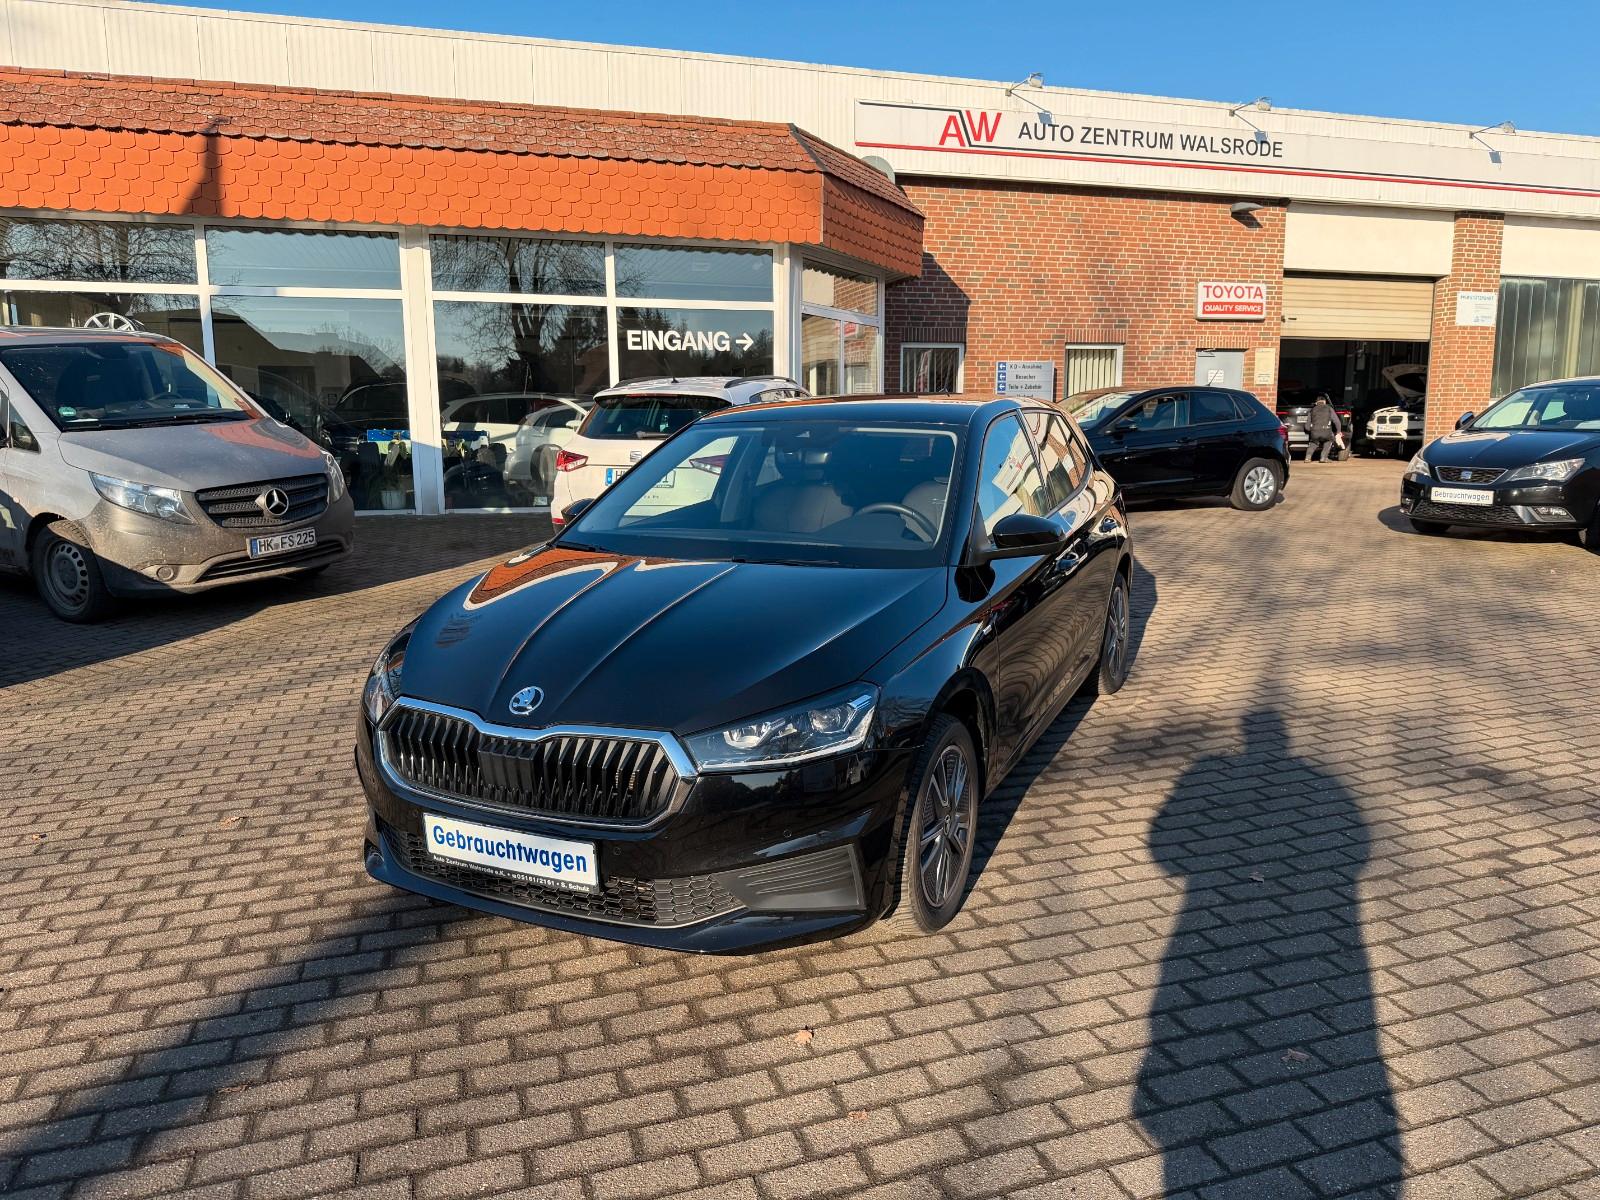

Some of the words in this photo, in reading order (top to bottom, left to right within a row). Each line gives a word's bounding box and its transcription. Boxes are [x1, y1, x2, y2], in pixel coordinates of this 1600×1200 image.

[1018, 122, 1075, 143] AUTO
[1080, 126, 1174, 150] ZENTRUM
[1180, 133, 1283, 158] WALSRODE
[1203, 285, 1264, 299] TOYOTA
[1204, 304, 1234, 312] QUALITY
[1234, 304, 1262, 312] SERVICE
[627, 329, 731, 352] EINGANG
[1434, 490, 1490, 501] Gebrauchtwagen
[258, 538, 274, 553] HK
[280, 535, 295, 549] FS
[296, 531, 315, 545] 225
[433, 825, 587, 873] Gebrauchtwagen
[446, 857, 468, 868] Zentrum
[469, 863, 494, 874] Walsrode
